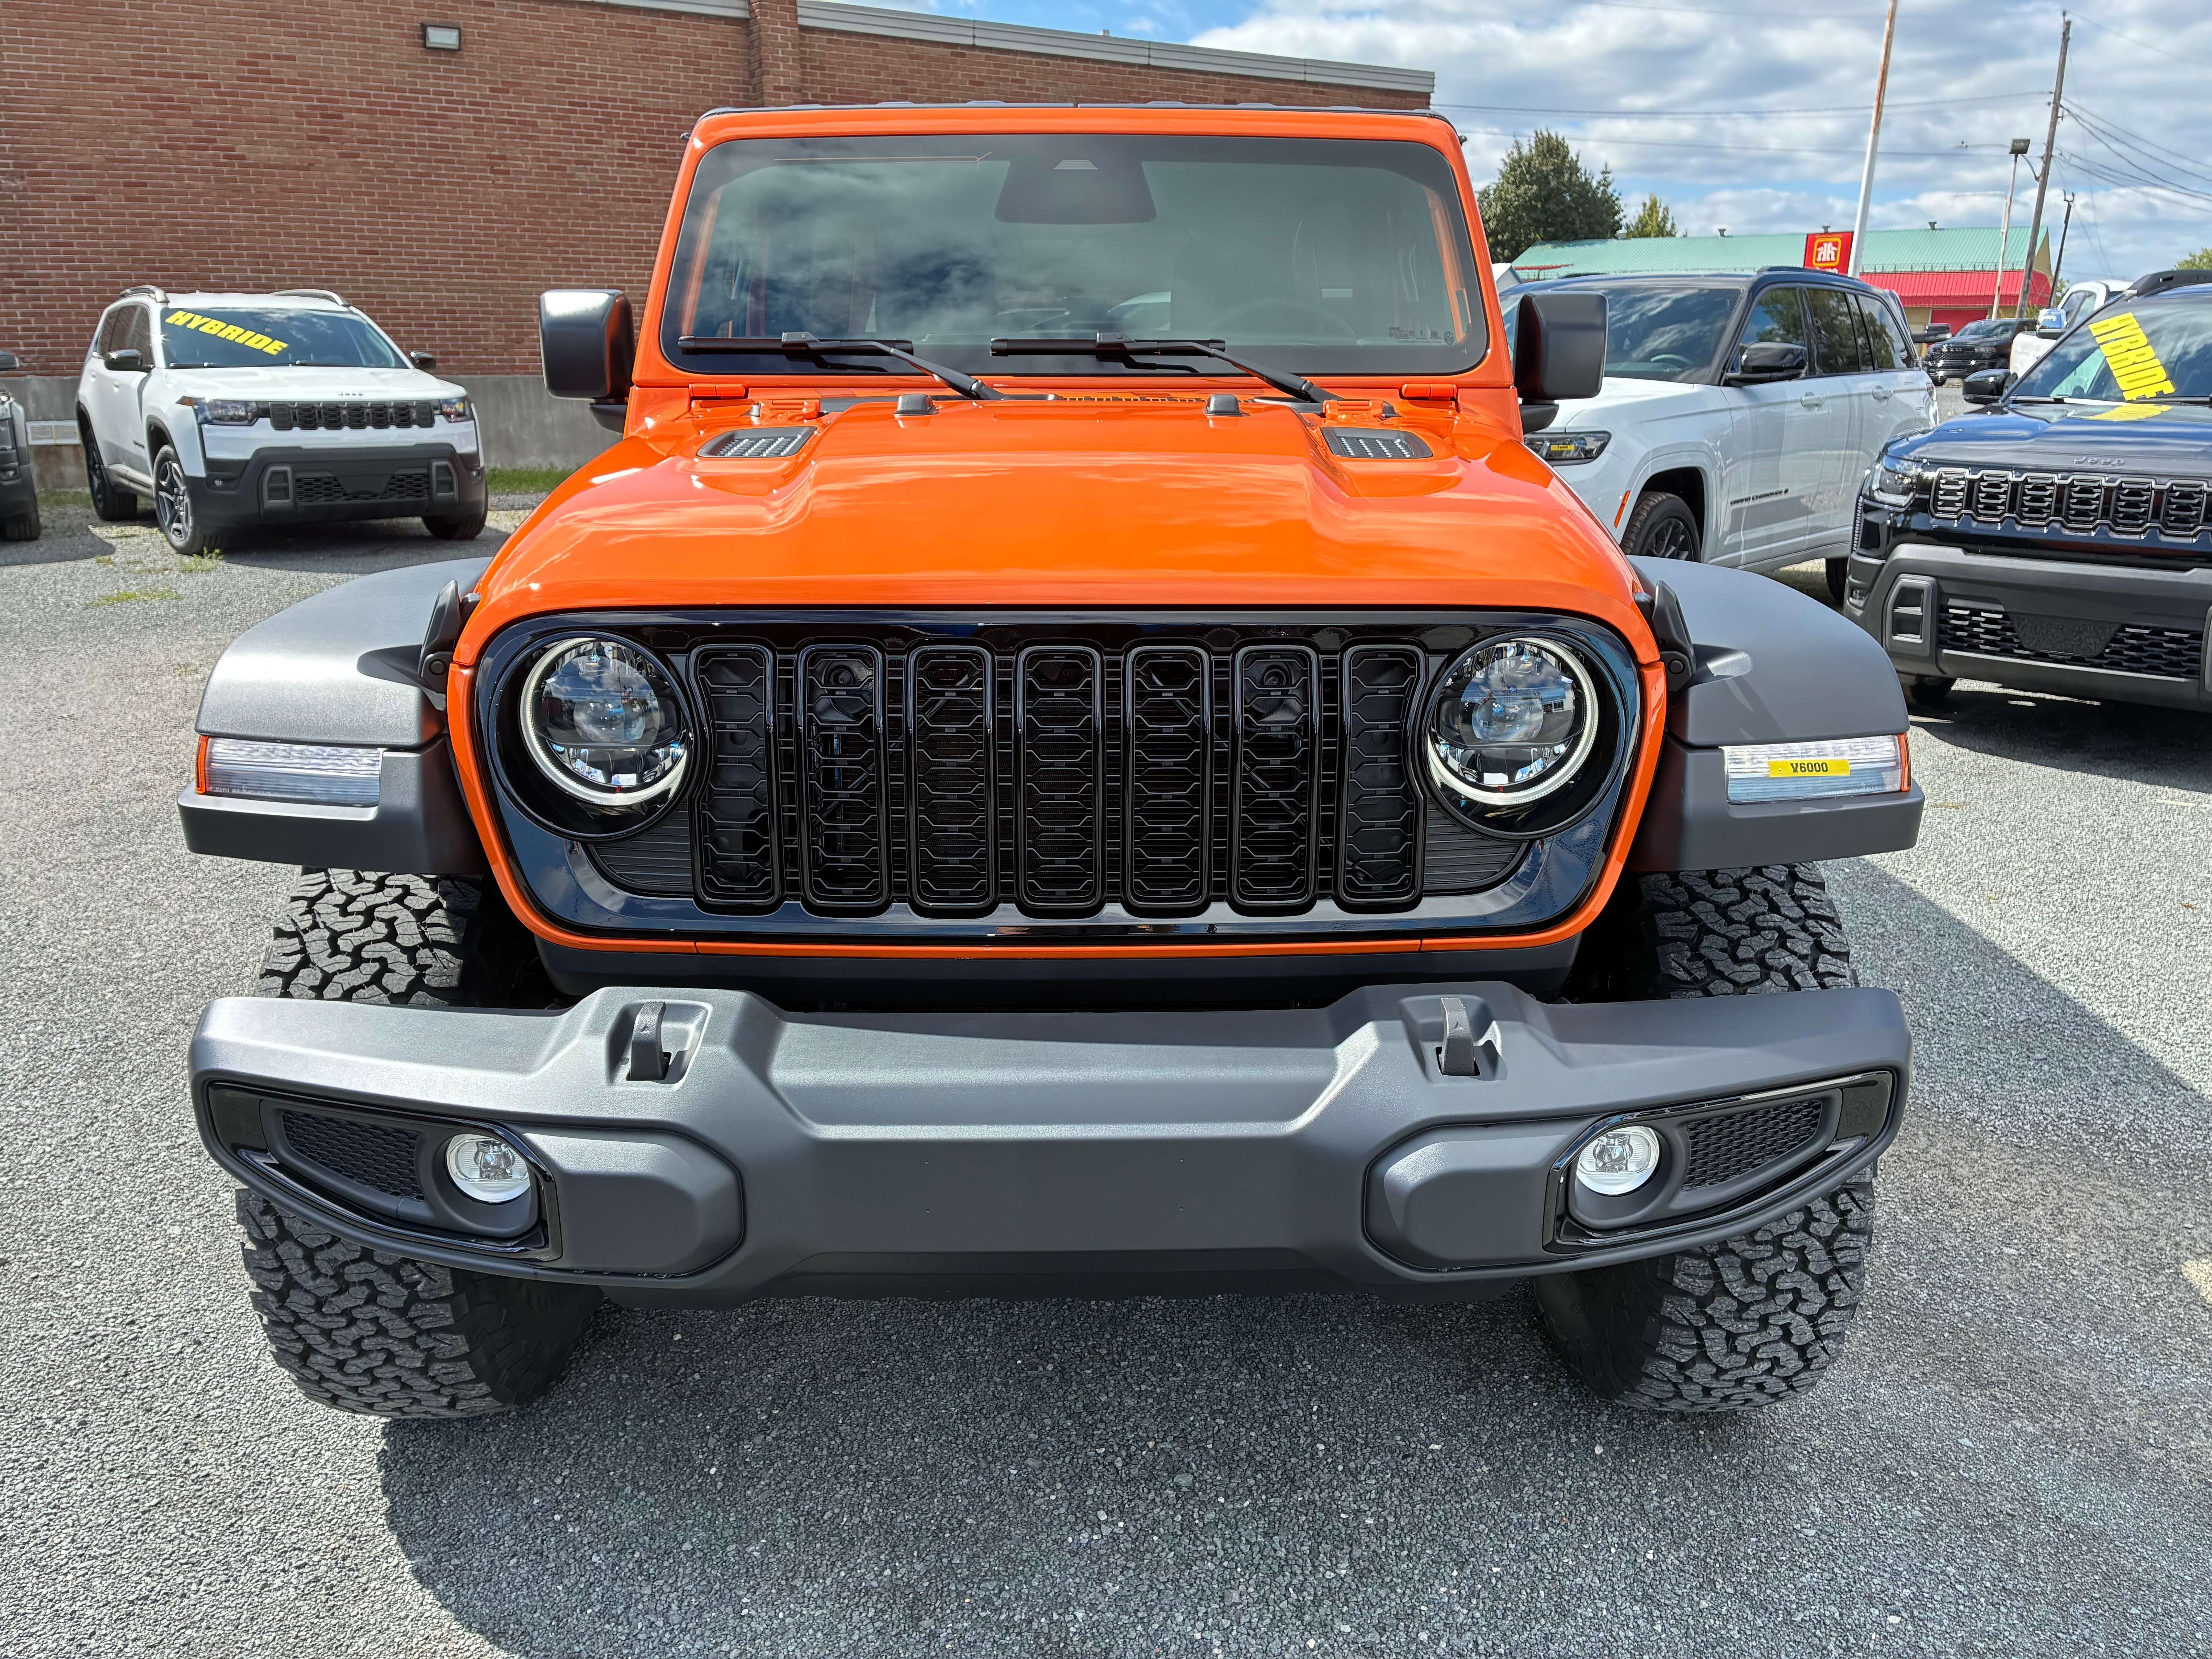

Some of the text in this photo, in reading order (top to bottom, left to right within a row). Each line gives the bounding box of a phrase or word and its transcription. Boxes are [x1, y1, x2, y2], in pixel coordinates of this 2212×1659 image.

[165, 311, 289, 355] HYBRIDE
[2088, 312, 2175, 401] HYBRIDE
[2073, 456, 2125, 467] Jeep
[1790, 762, 1828, 773] V6000
